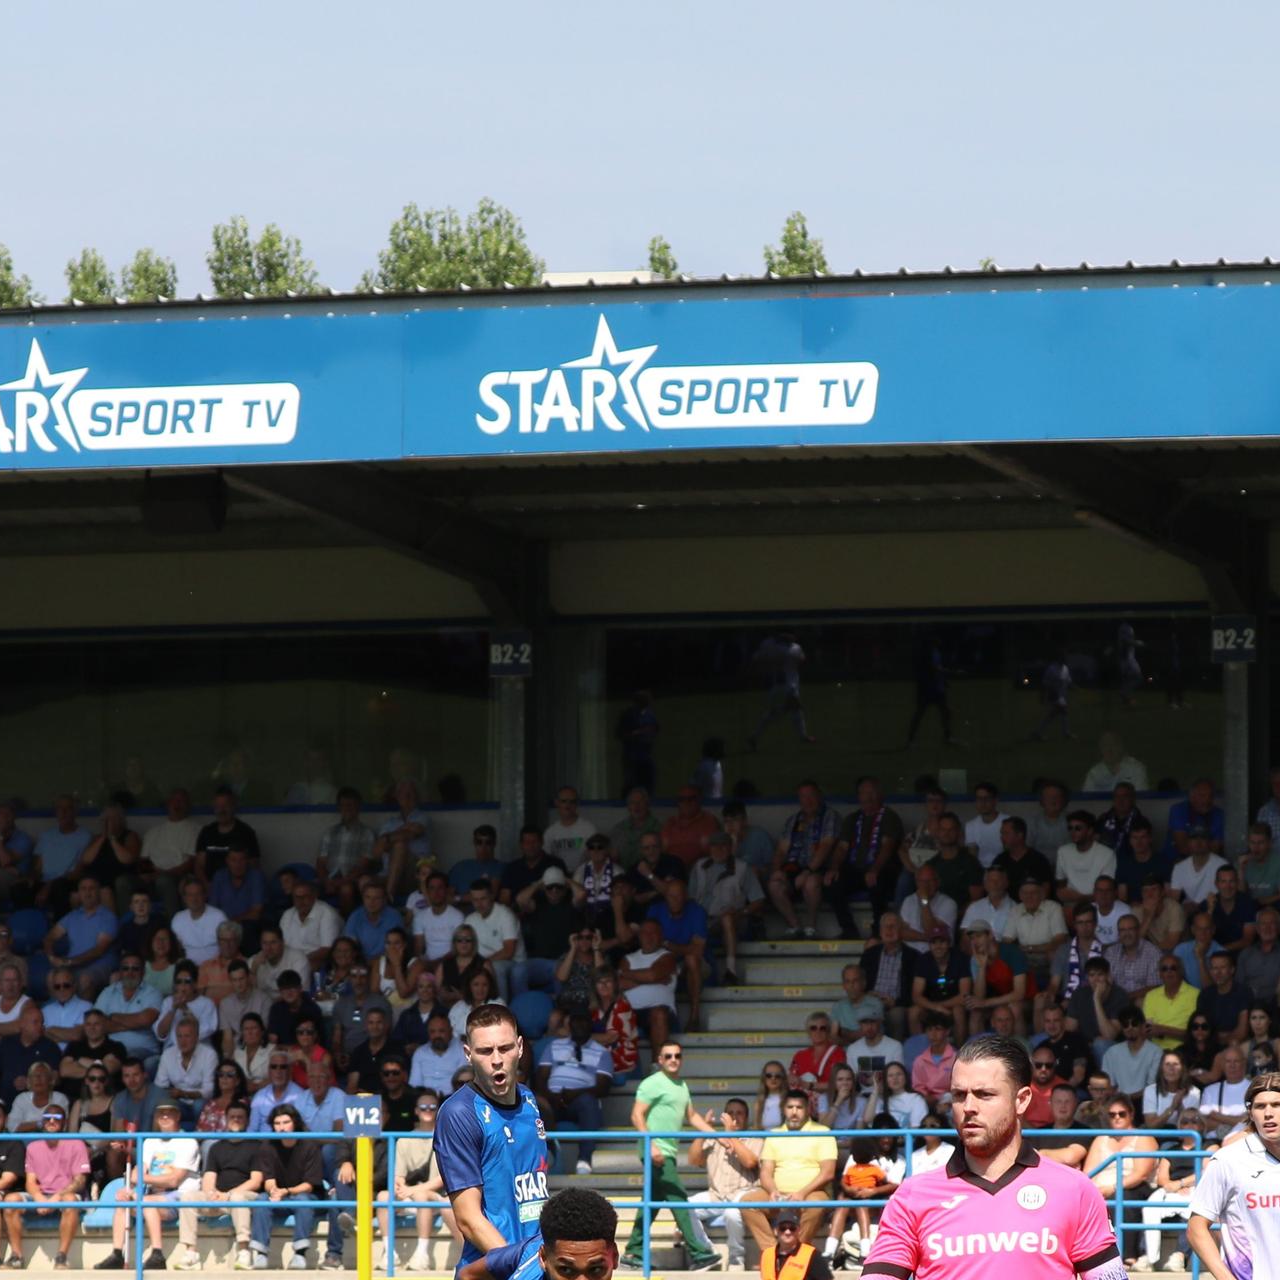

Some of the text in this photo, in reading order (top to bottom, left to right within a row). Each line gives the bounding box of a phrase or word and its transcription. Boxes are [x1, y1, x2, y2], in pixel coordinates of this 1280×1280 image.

[88, 396, 224, 438] SPORT
[242, 399, 287, 429] TV
[476, 367, 865, 436] STAR SPORT TV
[489, 643, 531, 665] B2-2
[1212, 628, 1256, 650] B2-2
[345, 1107, 380, 1125] V1.2
[514, 1171, 550, 1203] STAR
[927, 1227, 1059, 1261] Sunweb
